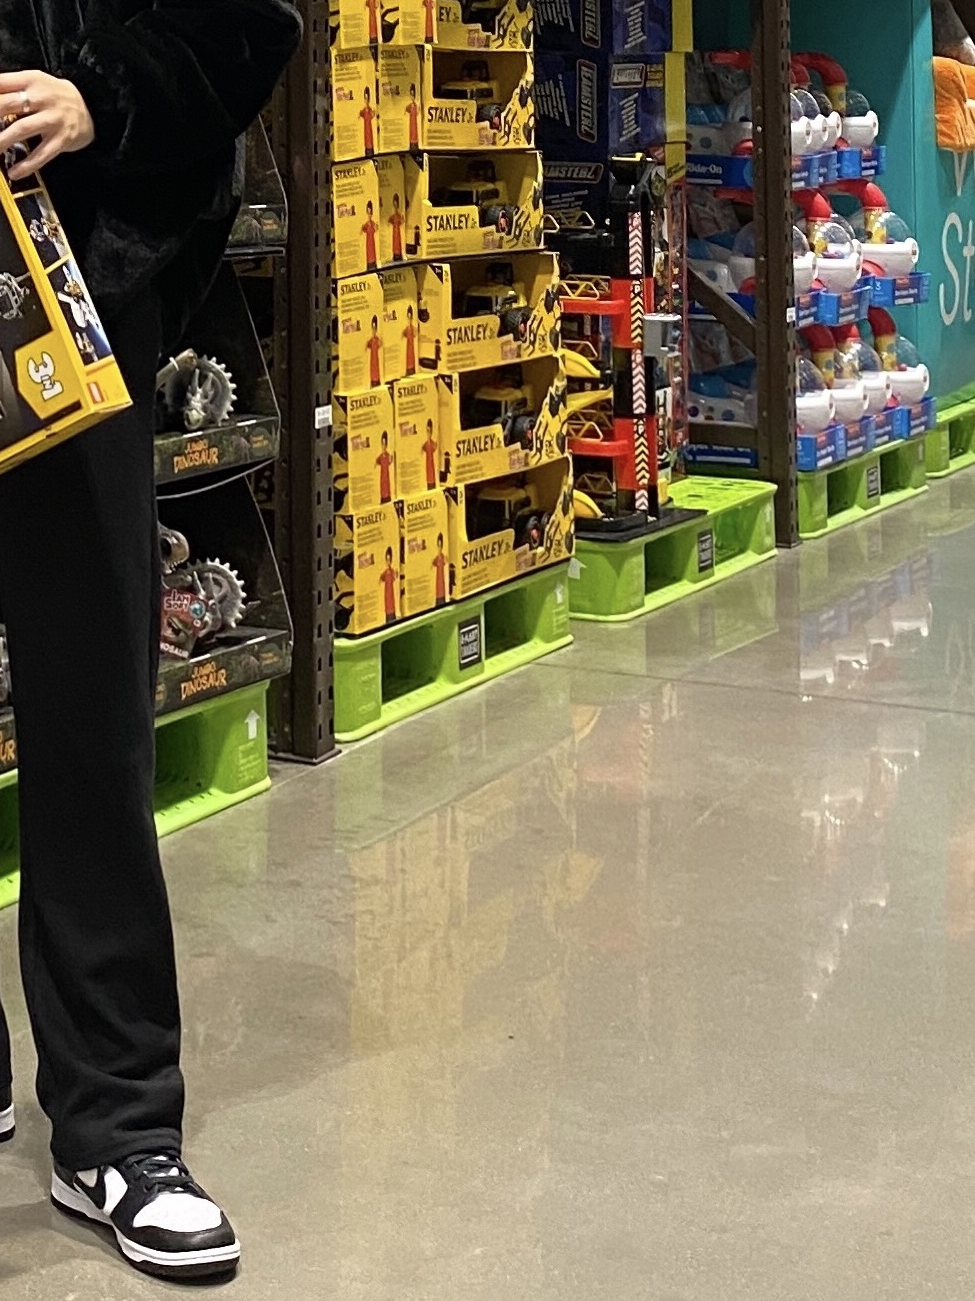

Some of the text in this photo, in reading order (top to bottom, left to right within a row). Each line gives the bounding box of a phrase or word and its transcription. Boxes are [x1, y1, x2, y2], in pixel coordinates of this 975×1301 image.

[427, 106, 468, 124] STANLEY
[426, 213, 471, 232] STANLEY
[446, 323, 489, 346] STANLEY
[455, 434, 496, 458] STANLEY
[173, 447, 219, 474] DINOSAUR
[461, 538, 505, 570] STANLEY
[180, 668, 228, 701] DINOSAUR
